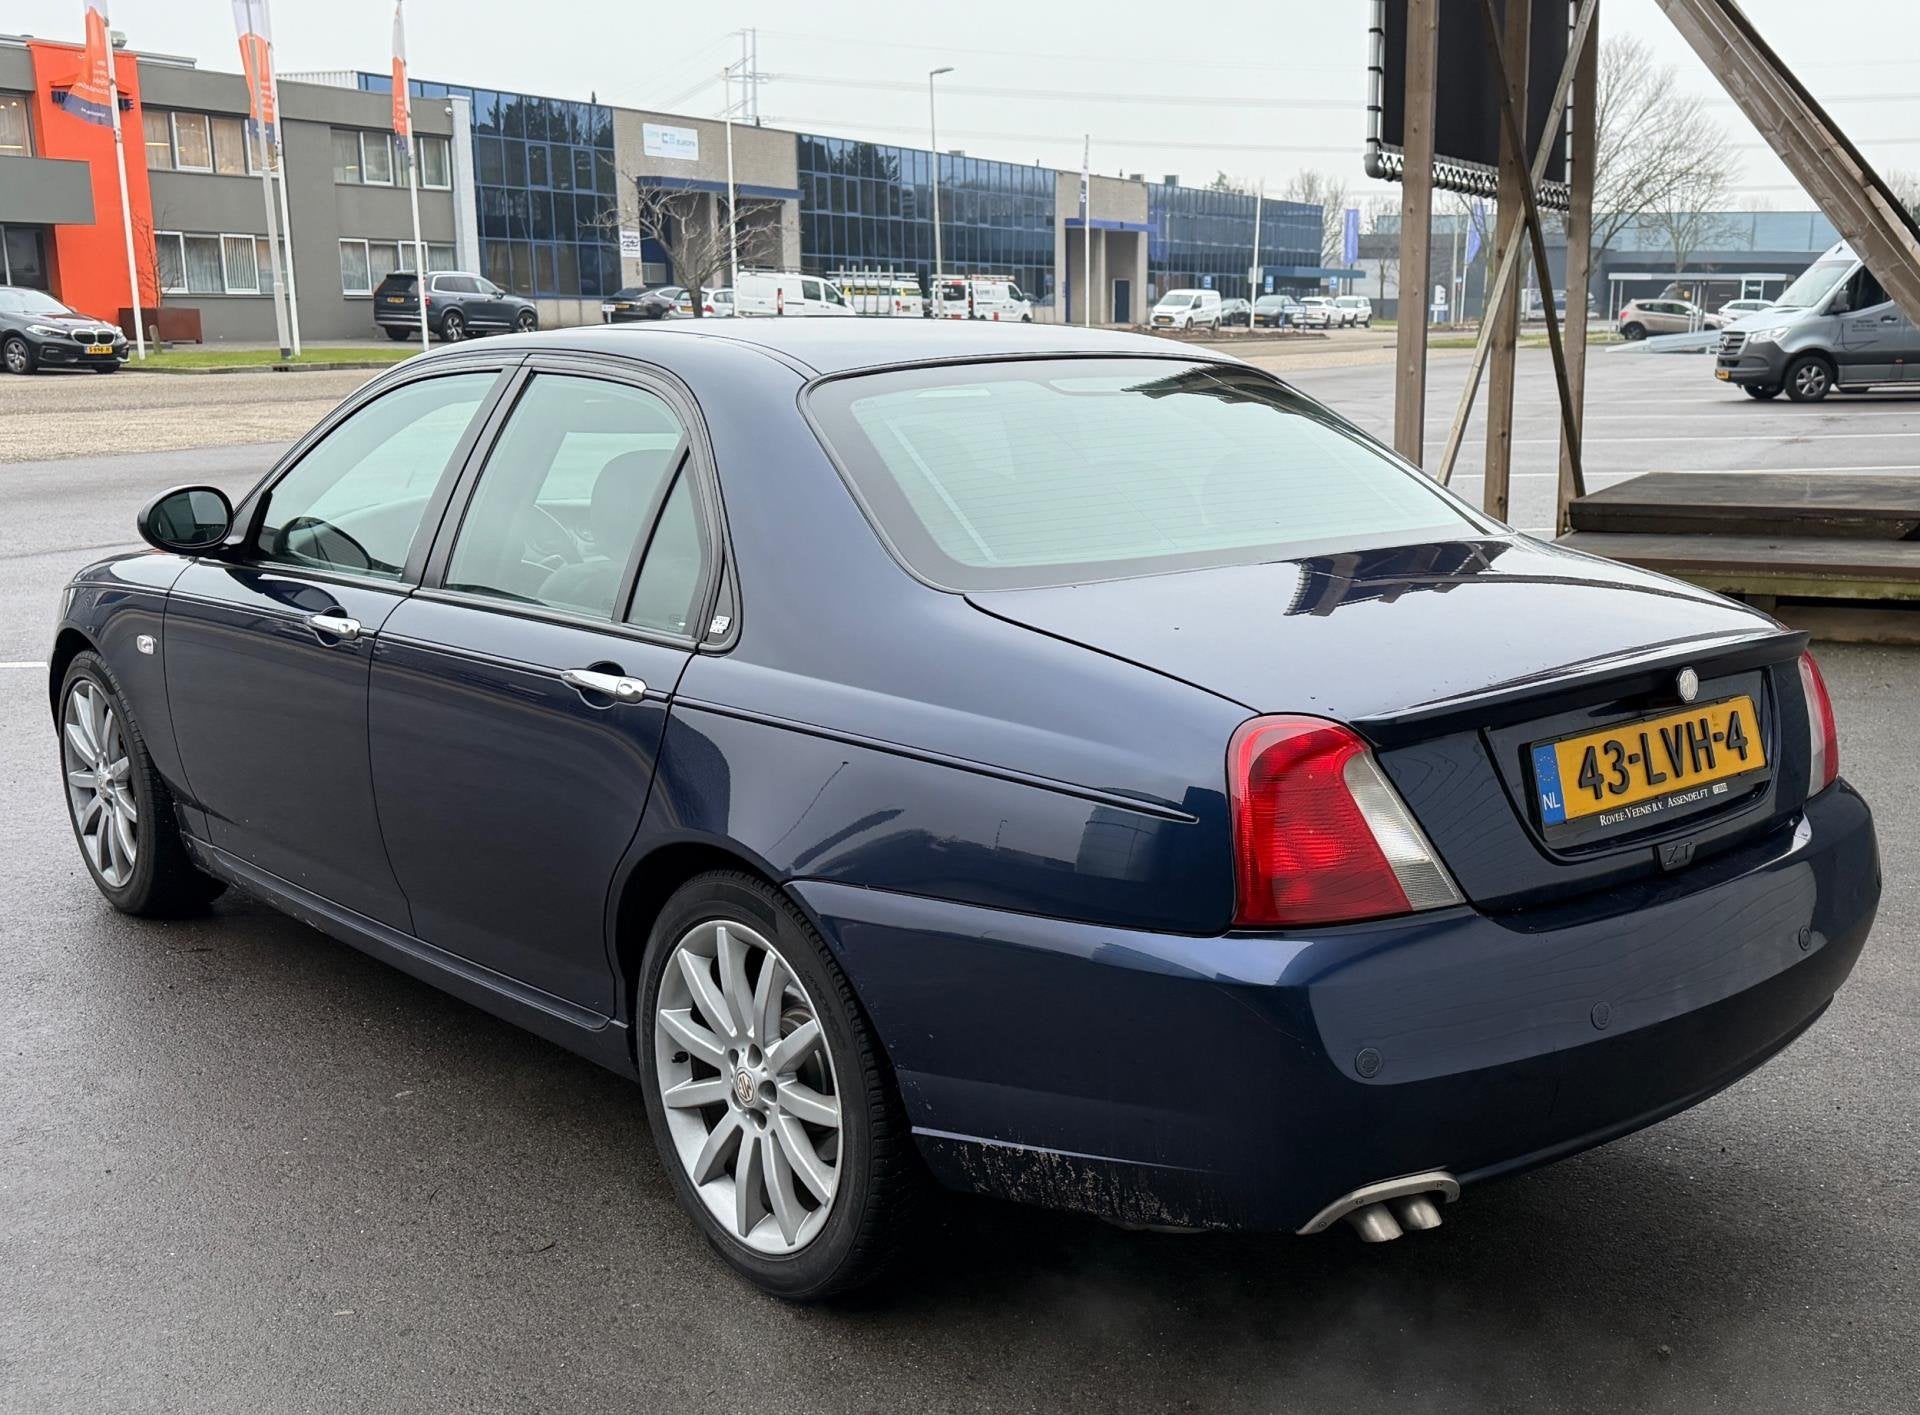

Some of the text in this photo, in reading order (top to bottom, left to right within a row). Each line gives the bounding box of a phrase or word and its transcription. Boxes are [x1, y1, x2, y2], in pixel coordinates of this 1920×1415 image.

[1579, 710, 1748, 800] 43-LVH-4
[1543, 791, 1561, 810] NL
[1667, 788, 1708, 808] ASSENDELFT
